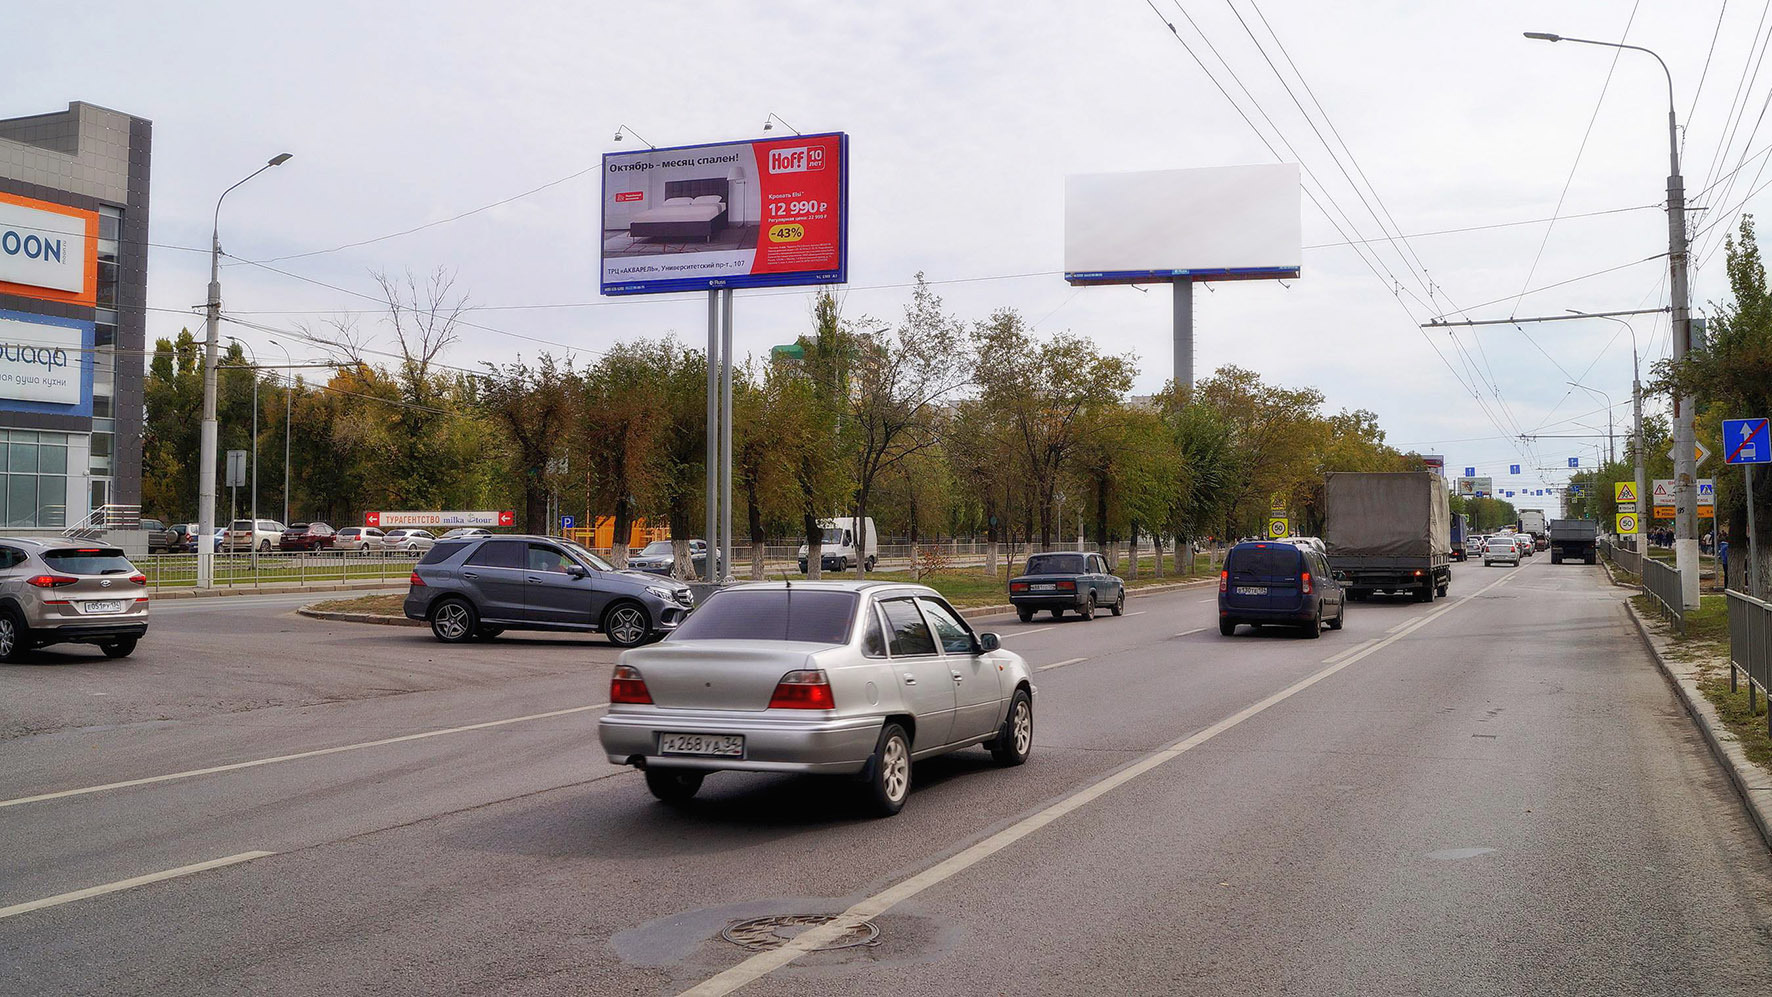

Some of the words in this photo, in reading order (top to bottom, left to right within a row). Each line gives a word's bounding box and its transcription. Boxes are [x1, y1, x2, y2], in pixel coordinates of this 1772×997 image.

[809, 149, 823, 160] 10
[609, 161, 654, 172] Октябрь
[662, 158, 694, 168] месяц
[697, 153, 739, 165] спален!
[771, 151, 804, 170] Hoff
[768, 202, 787, 216] 12
[790, 200, 818, 214] 990
[771, 227, 802, 238] -43%
[661, 261, 715, 272] Университетский
[15, 375, 40, 386] душа
[42, 377, 67, 388] кухни
[386, 515, 440, 524] ТУРАГЕНТСТВО
[443, 516, 465, 524] milka
[1622, 519, 1633, 527] 50
